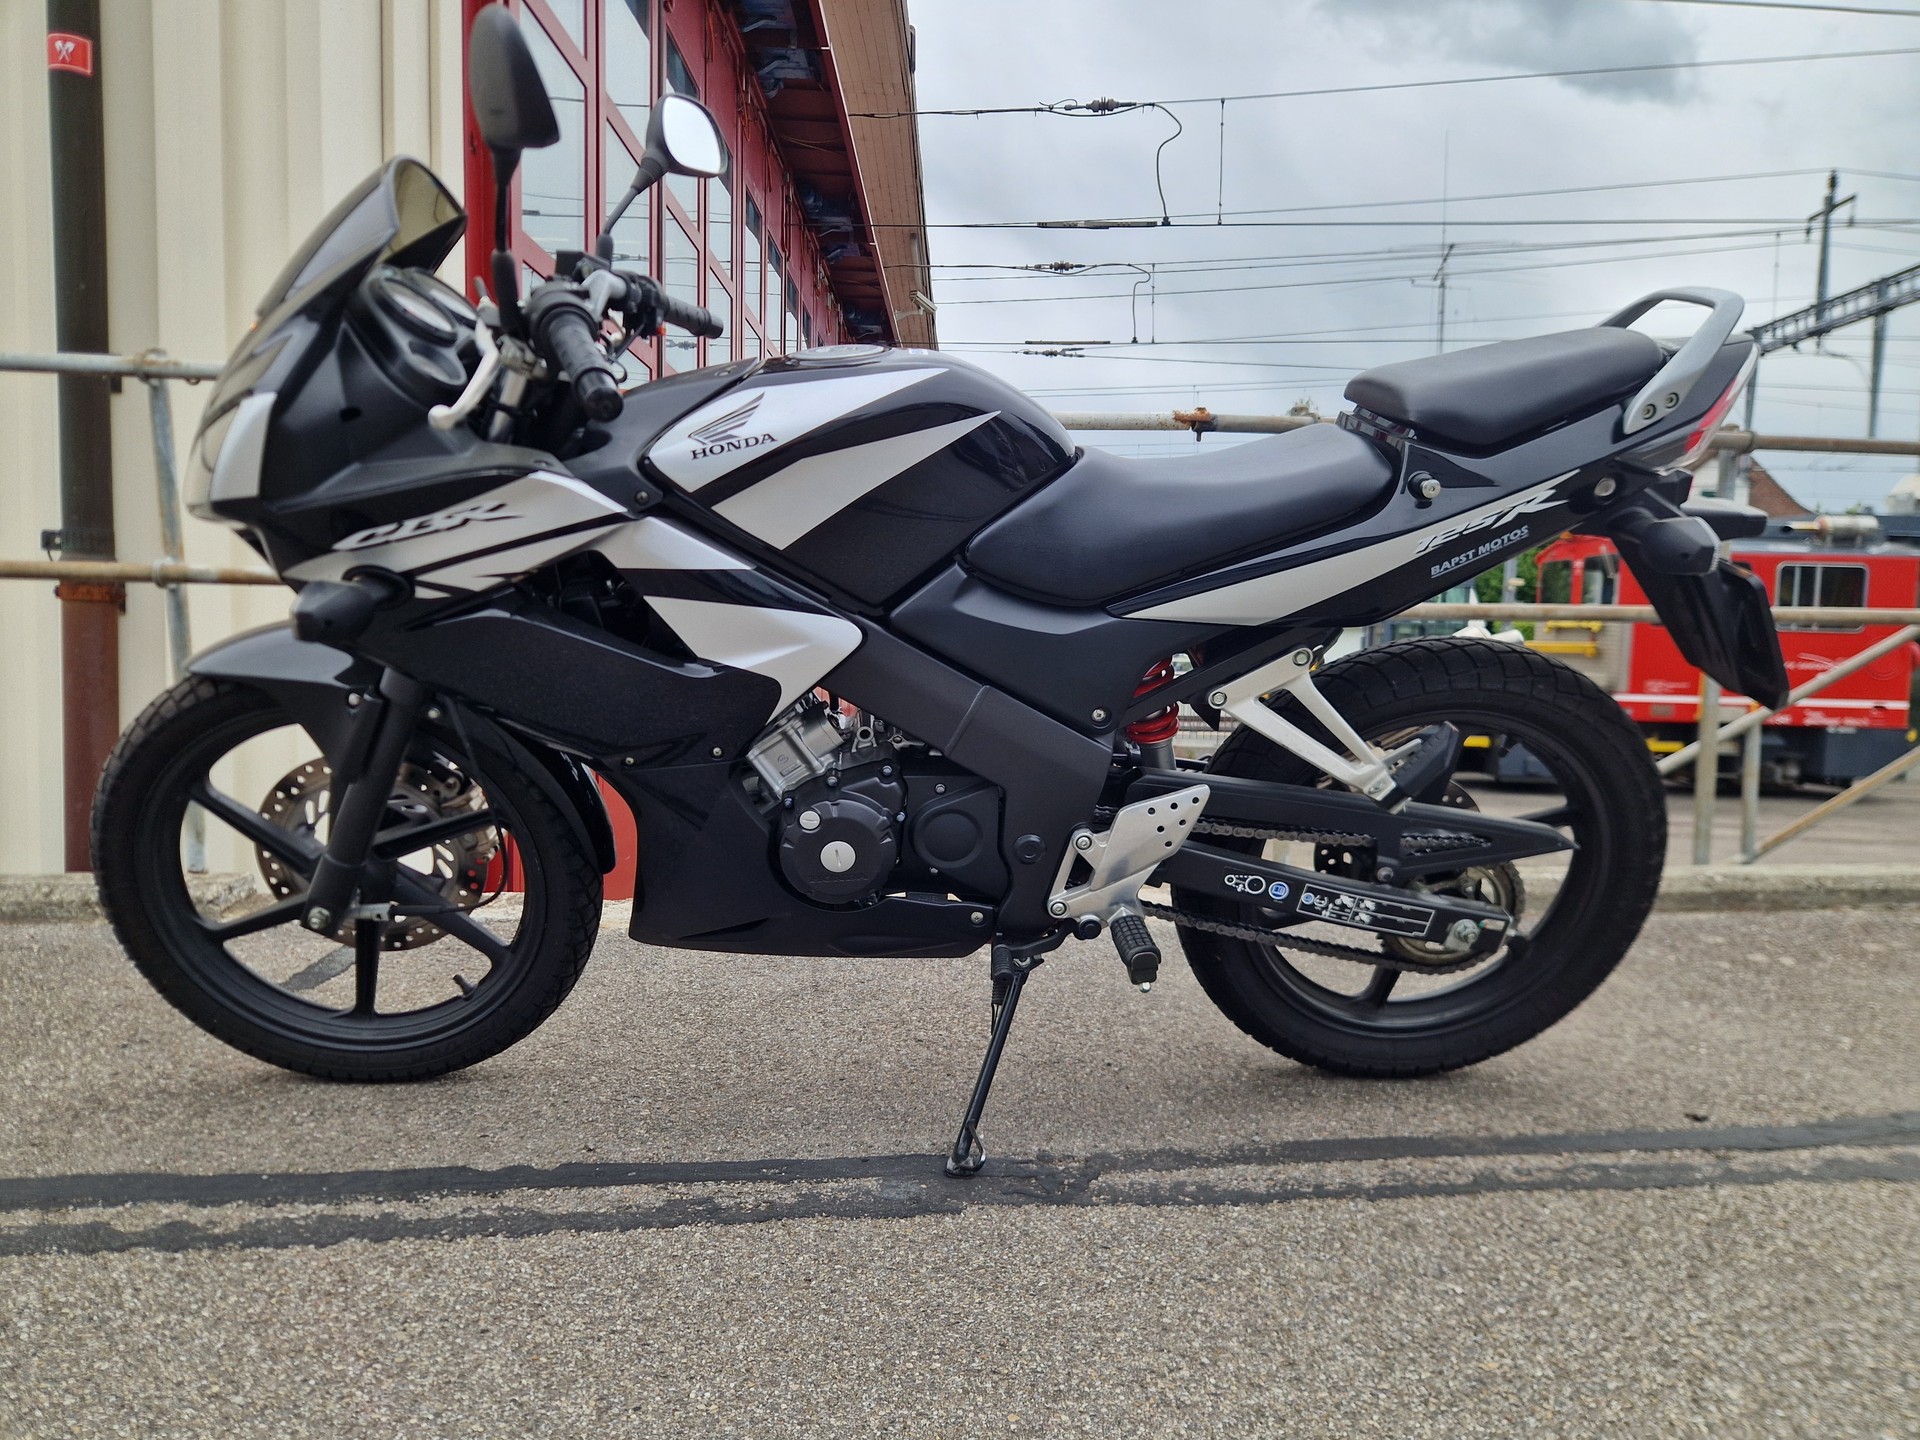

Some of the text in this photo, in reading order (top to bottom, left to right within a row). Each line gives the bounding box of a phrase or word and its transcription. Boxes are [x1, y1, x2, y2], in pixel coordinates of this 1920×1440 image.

[690, 433, 778, 460] HONDA
[331, 503, 525, 551] CBR
[1430, 525, 1529, 576] BAPST MOTOS
